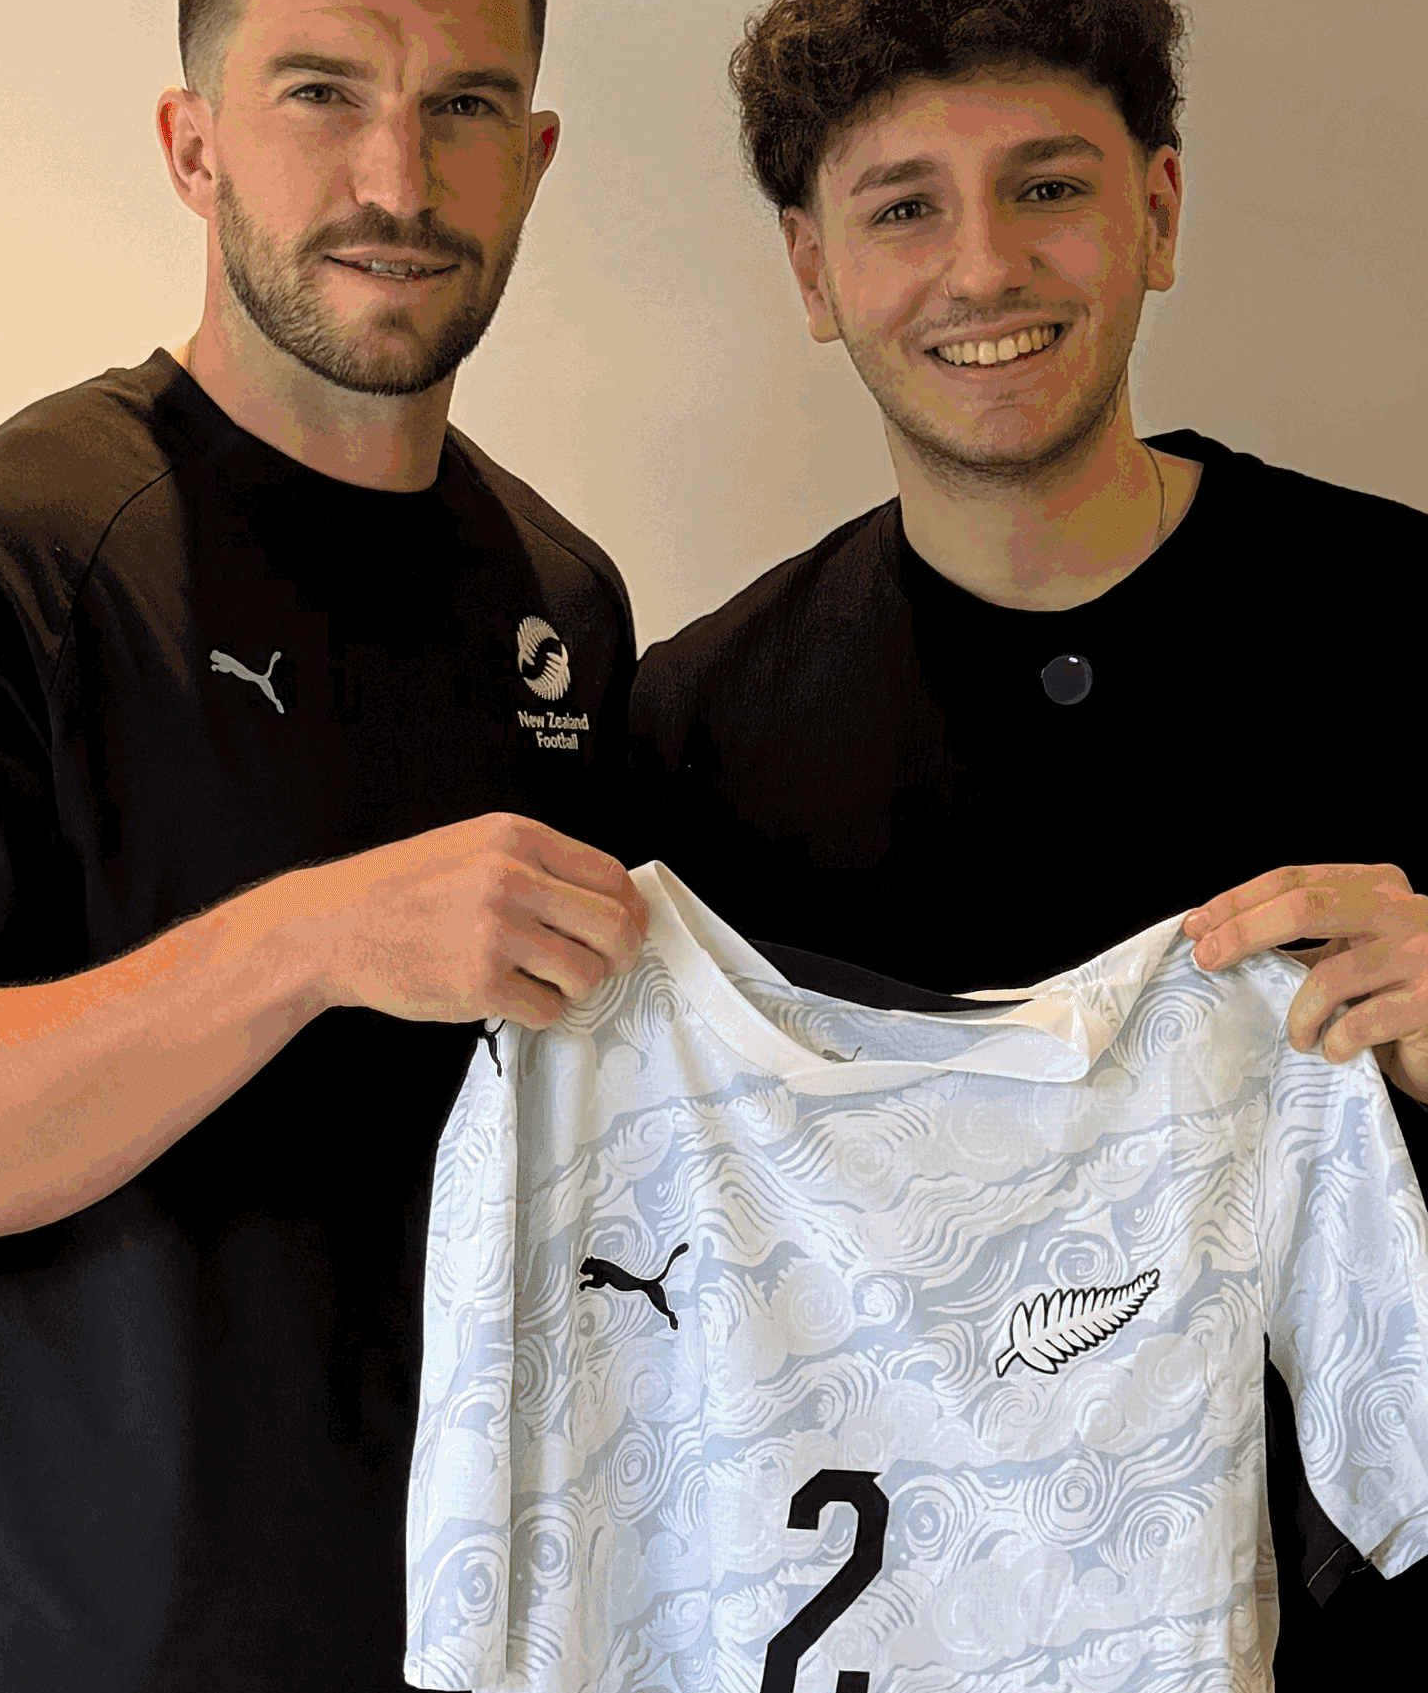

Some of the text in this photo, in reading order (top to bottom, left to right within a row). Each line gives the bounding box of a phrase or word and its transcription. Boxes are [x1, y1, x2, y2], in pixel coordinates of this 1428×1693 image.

[517, 710, 590, 730] New Zealand
[535, 730, 579, 750] Football
